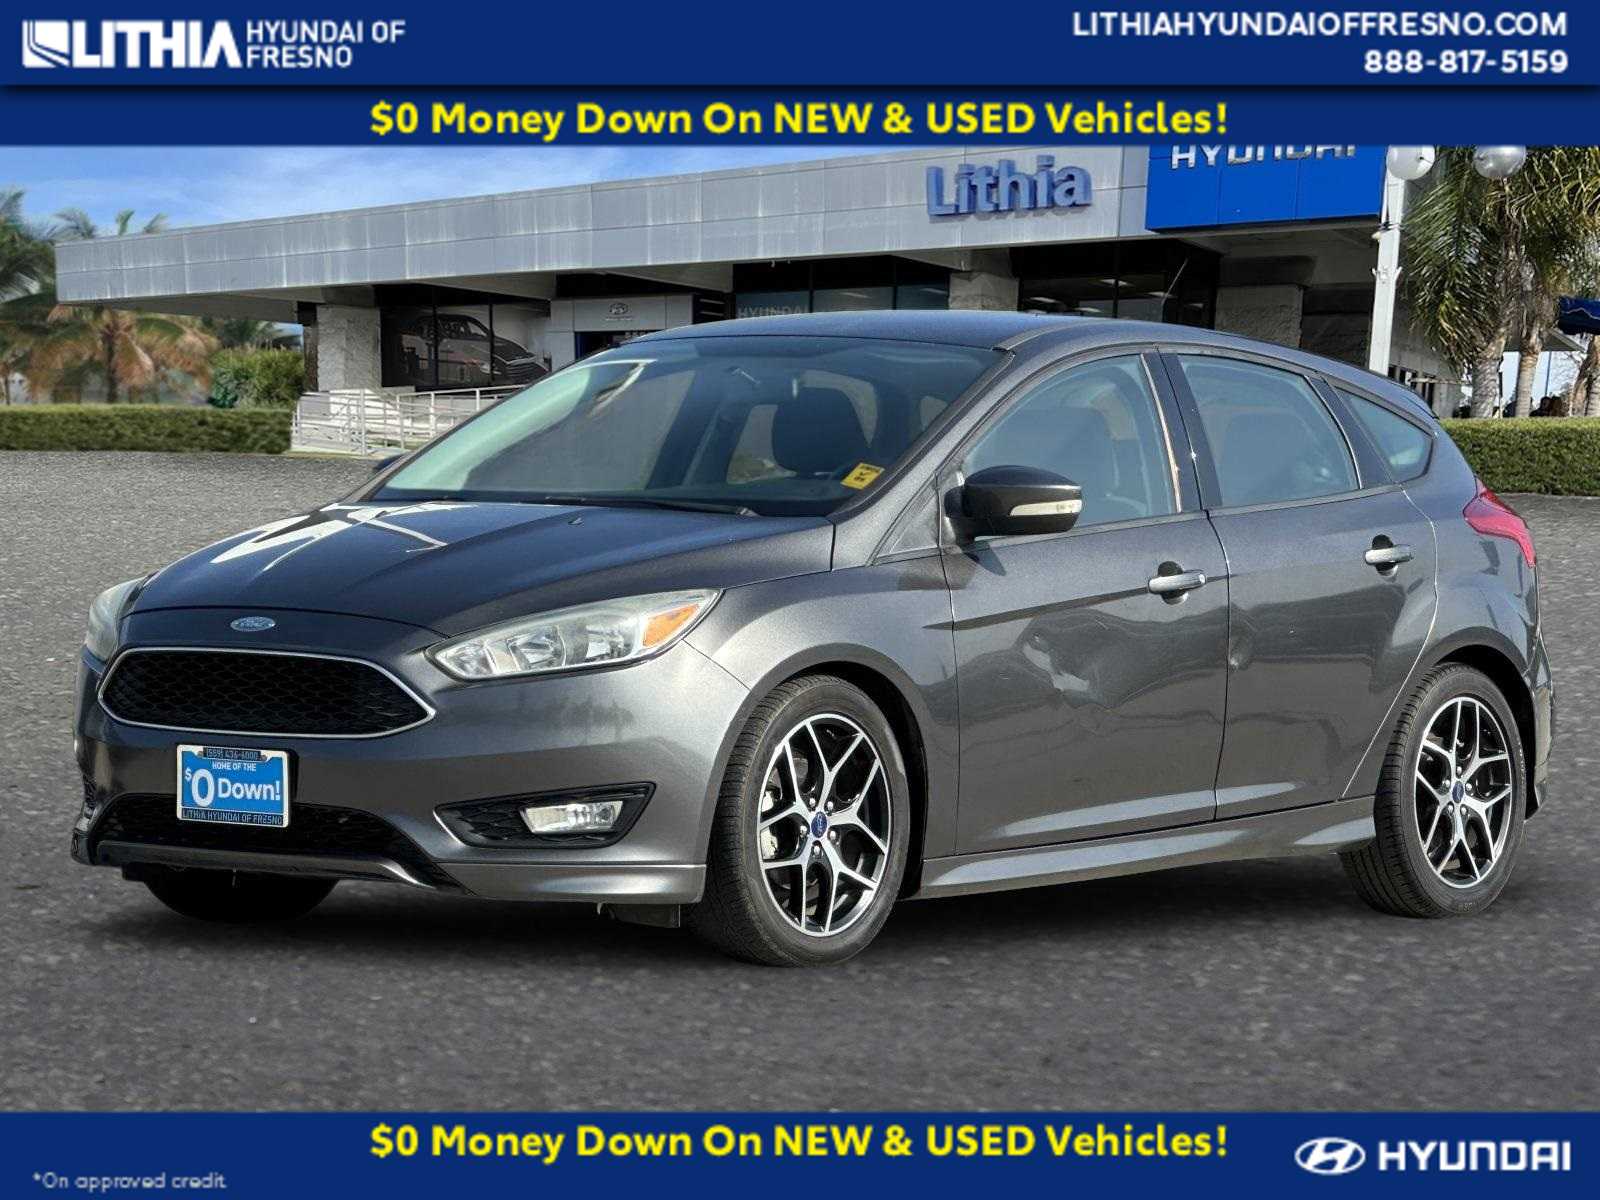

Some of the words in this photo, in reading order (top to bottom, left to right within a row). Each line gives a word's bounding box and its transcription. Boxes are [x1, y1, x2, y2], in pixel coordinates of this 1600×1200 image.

[926, 155, 1092, 216] Lithia
[212, 761, 232, 770] HOME
[232, 762, 242, 771] OF
[243, 762, 257, 772] THE
[217, 778, 281, 801] Down!
[207, 810, 240, 822] HYUNDAI
[241, 814, 252, 823] OF
[253, 814, 283, 826] FRESNO
